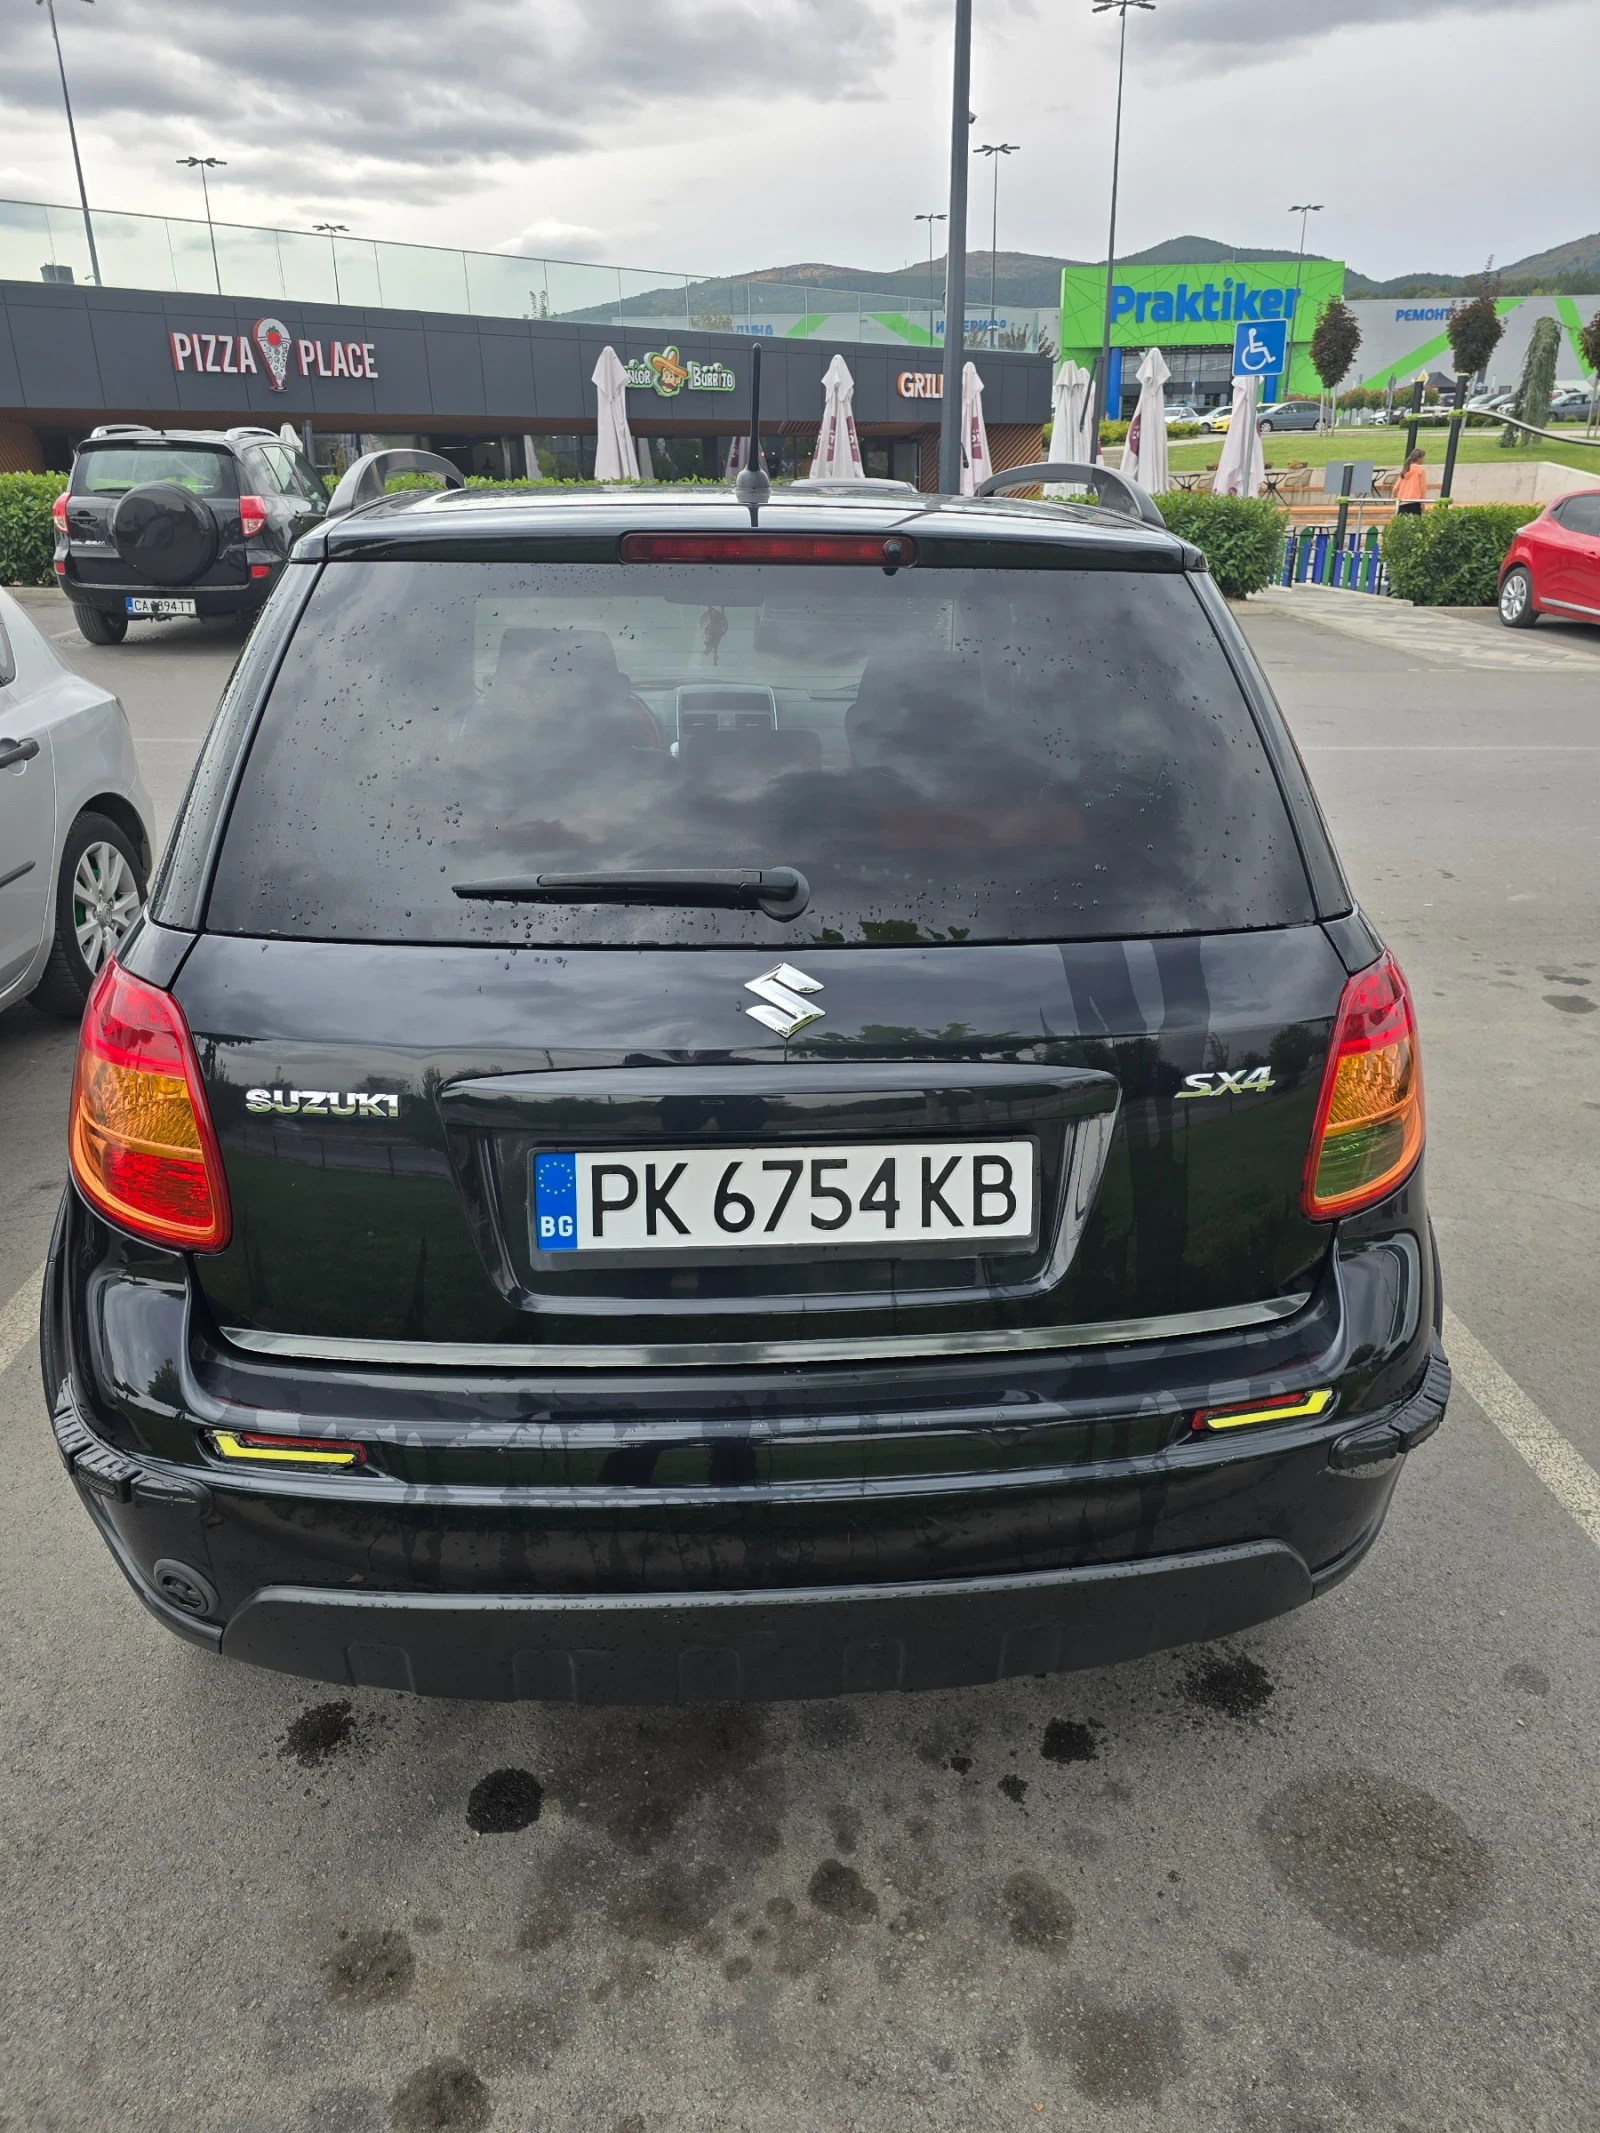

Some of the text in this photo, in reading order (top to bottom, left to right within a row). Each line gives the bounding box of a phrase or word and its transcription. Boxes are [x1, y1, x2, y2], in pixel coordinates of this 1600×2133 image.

[1110, 277, 1301, 323] Praktiker
[169, 332, 379, 379] PIZZA PLACE
[692, 365, 733, 388] BURRITO
[134, 600, 149, 611] CA
[156, 601, 177, 612] 894
[179, 601, 192, 612] TT
[1173, 1065, 1277, 1099] SX4
[245, 1088, 399, 1118] SUZUKI
[591, 1155, 1018, 1237] PK 6754 KB
[540, 1215, 574, 1238] BG
